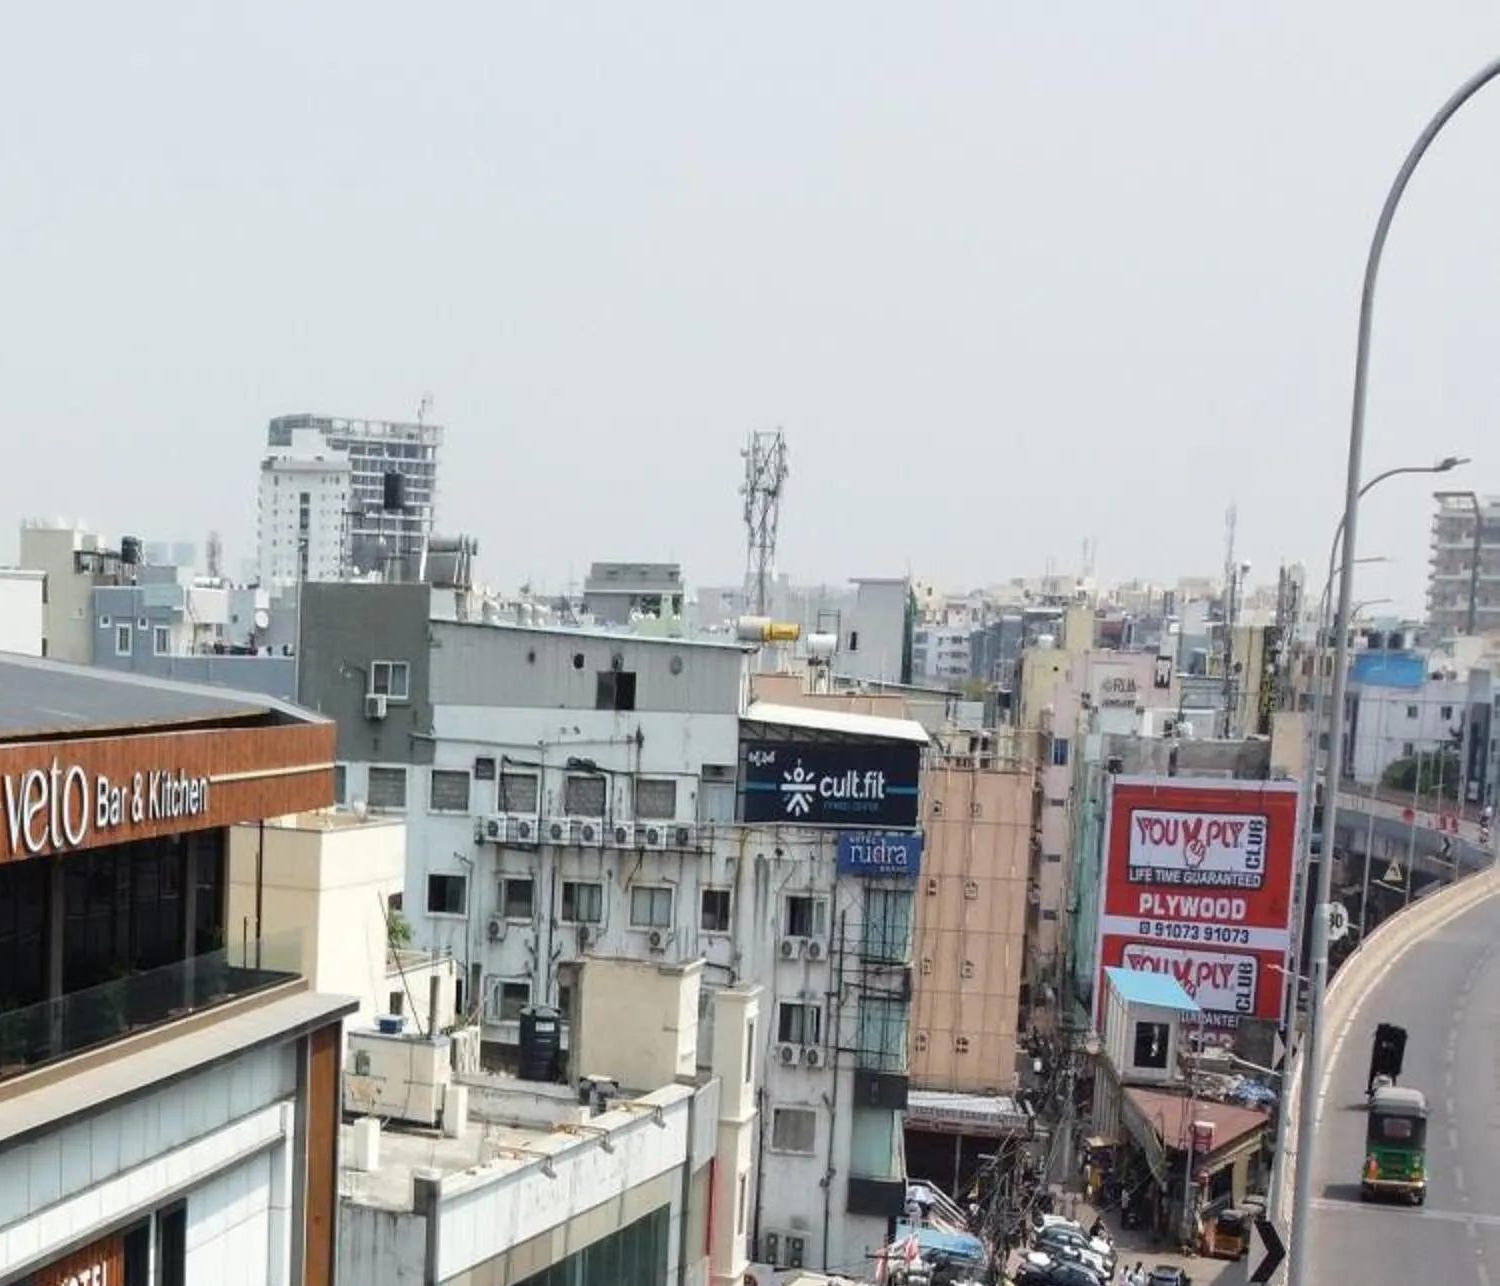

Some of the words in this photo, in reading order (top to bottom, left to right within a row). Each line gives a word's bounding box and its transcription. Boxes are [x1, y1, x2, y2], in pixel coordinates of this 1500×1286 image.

[819, 769, 885, 800] cult.fit
[4, 756, 89, 854] veto
[96, 776, 128, 828] Bar
[132, 772, 144, 823] &
[149, 769, 209, 820] Kitchen
[1136, 816, 1179, 846] YOU
[1206, 820, 1246, 849] PLY
[1246, 819, 1264, 869] CLUB
[849, 838, 907, 865] rudra
[1129, 867, 1152, 881] LIFE
[1156, 869, 1180, 883] TIME
[1183, 871, 1261, 887] GUARANTEED
[1139, 893, 1247, 920] PLYWOOD
[1155, 922, 1199, 940] 91073
[1203, 925, 1249, 943] 91073
[1200, 961, 1235, 989] PLY
[1236, 962, 1253, 1011] CLUB
